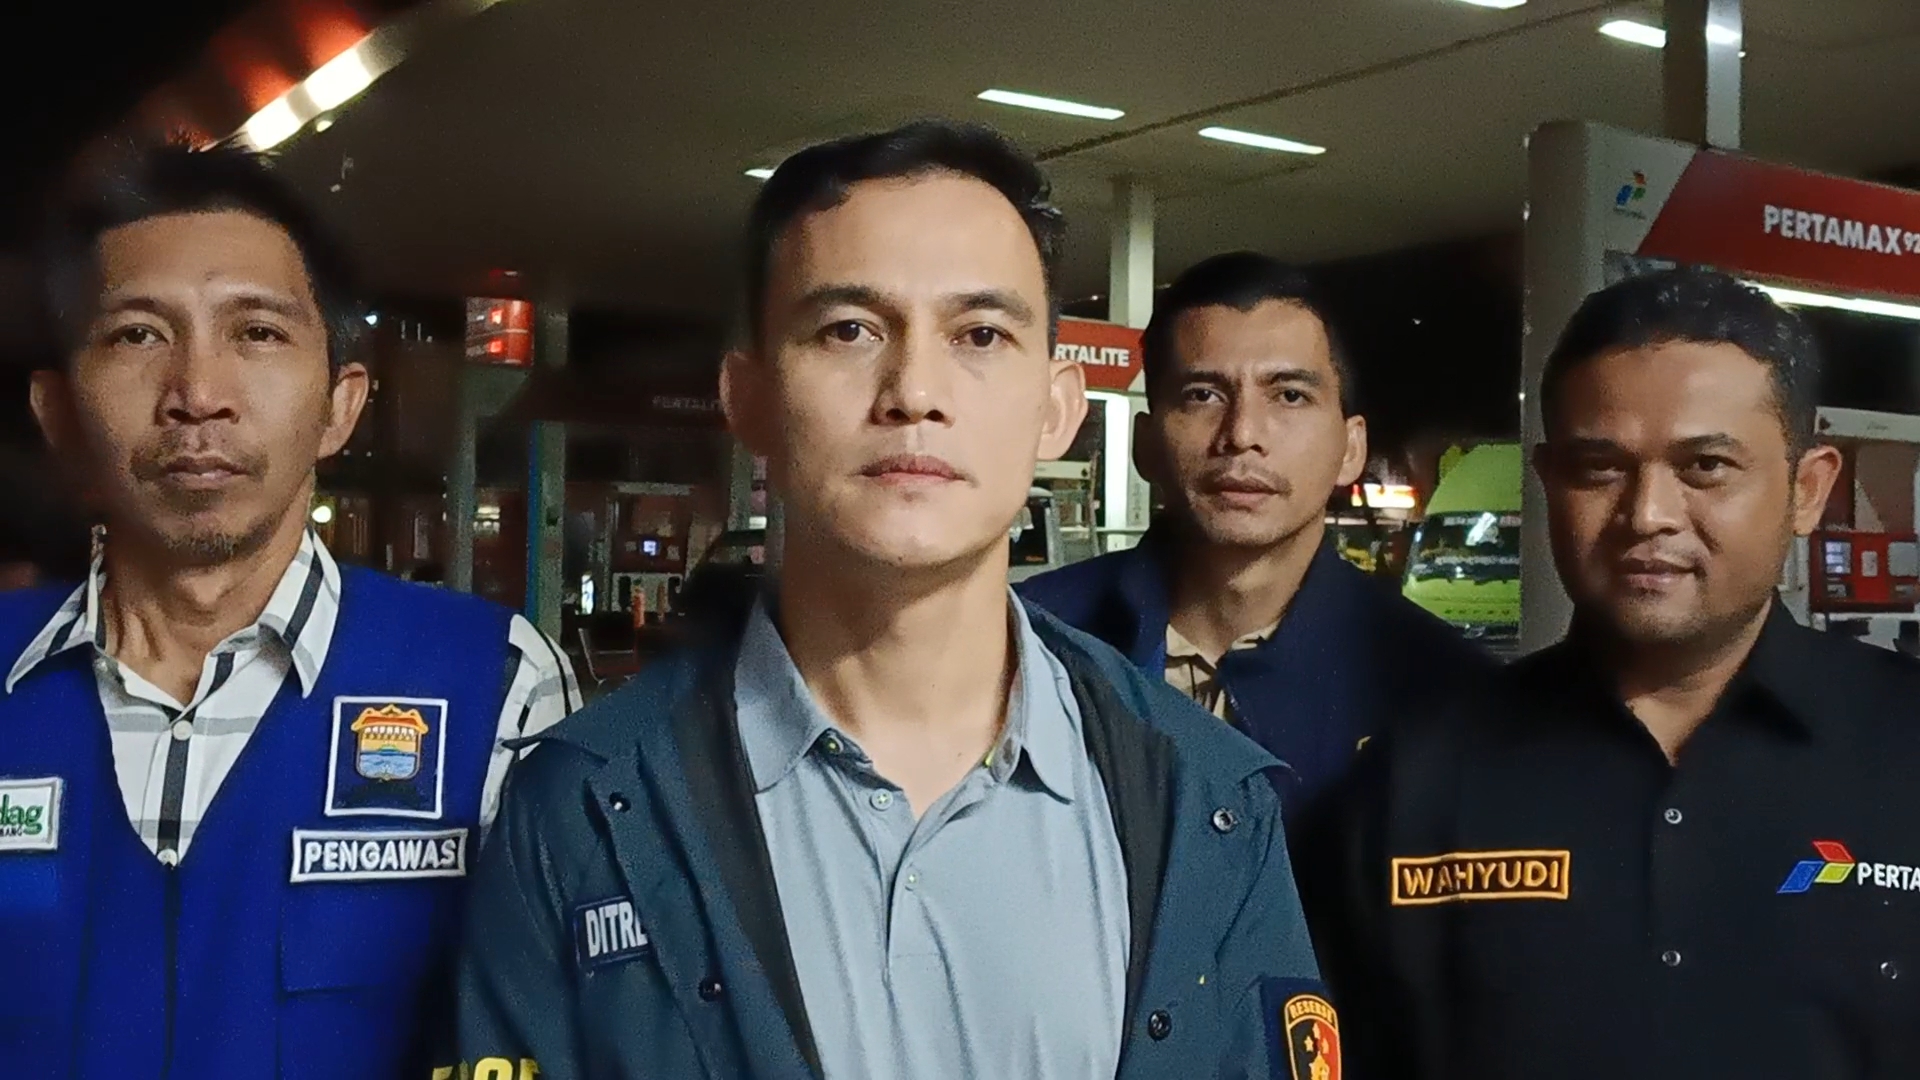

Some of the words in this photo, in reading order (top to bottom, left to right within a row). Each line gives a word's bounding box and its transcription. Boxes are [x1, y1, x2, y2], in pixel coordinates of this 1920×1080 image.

[1764, 204, 1902, 256] PERTAMAX
[304, 838, 457, 873] PENGAWAS
[1403, 860, 1559, 896] WAHYUDI
